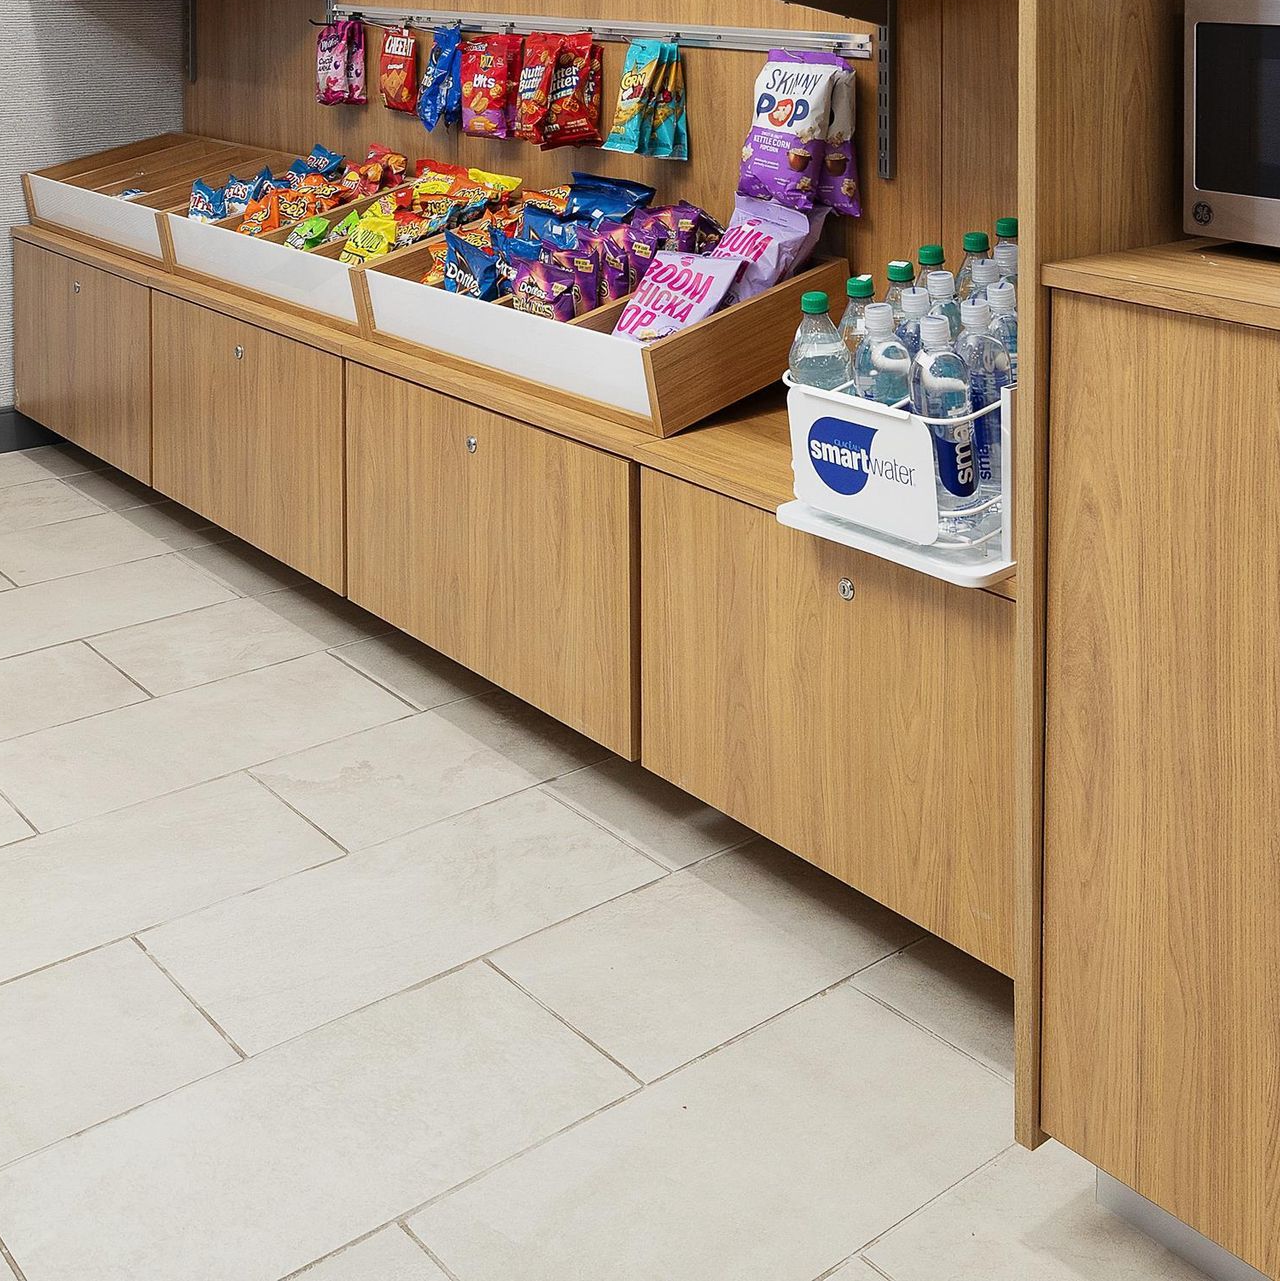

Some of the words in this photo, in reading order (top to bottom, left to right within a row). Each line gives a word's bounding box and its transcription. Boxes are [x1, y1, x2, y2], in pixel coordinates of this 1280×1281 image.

[621, 71, 646, 90] CORN
[766, 68, 823, 96] SKINNY
[756, 92, 810, 128] POP
[753, 134, 773, 146] KETTLE
[773, 138, 791, 150] CORN
[760, 144, 779, 153] POPCORN
[519, 281, 547, 299] Doritos
[633, 279, 695, 324] HICKA
[616, 304, 657, 335] OP
